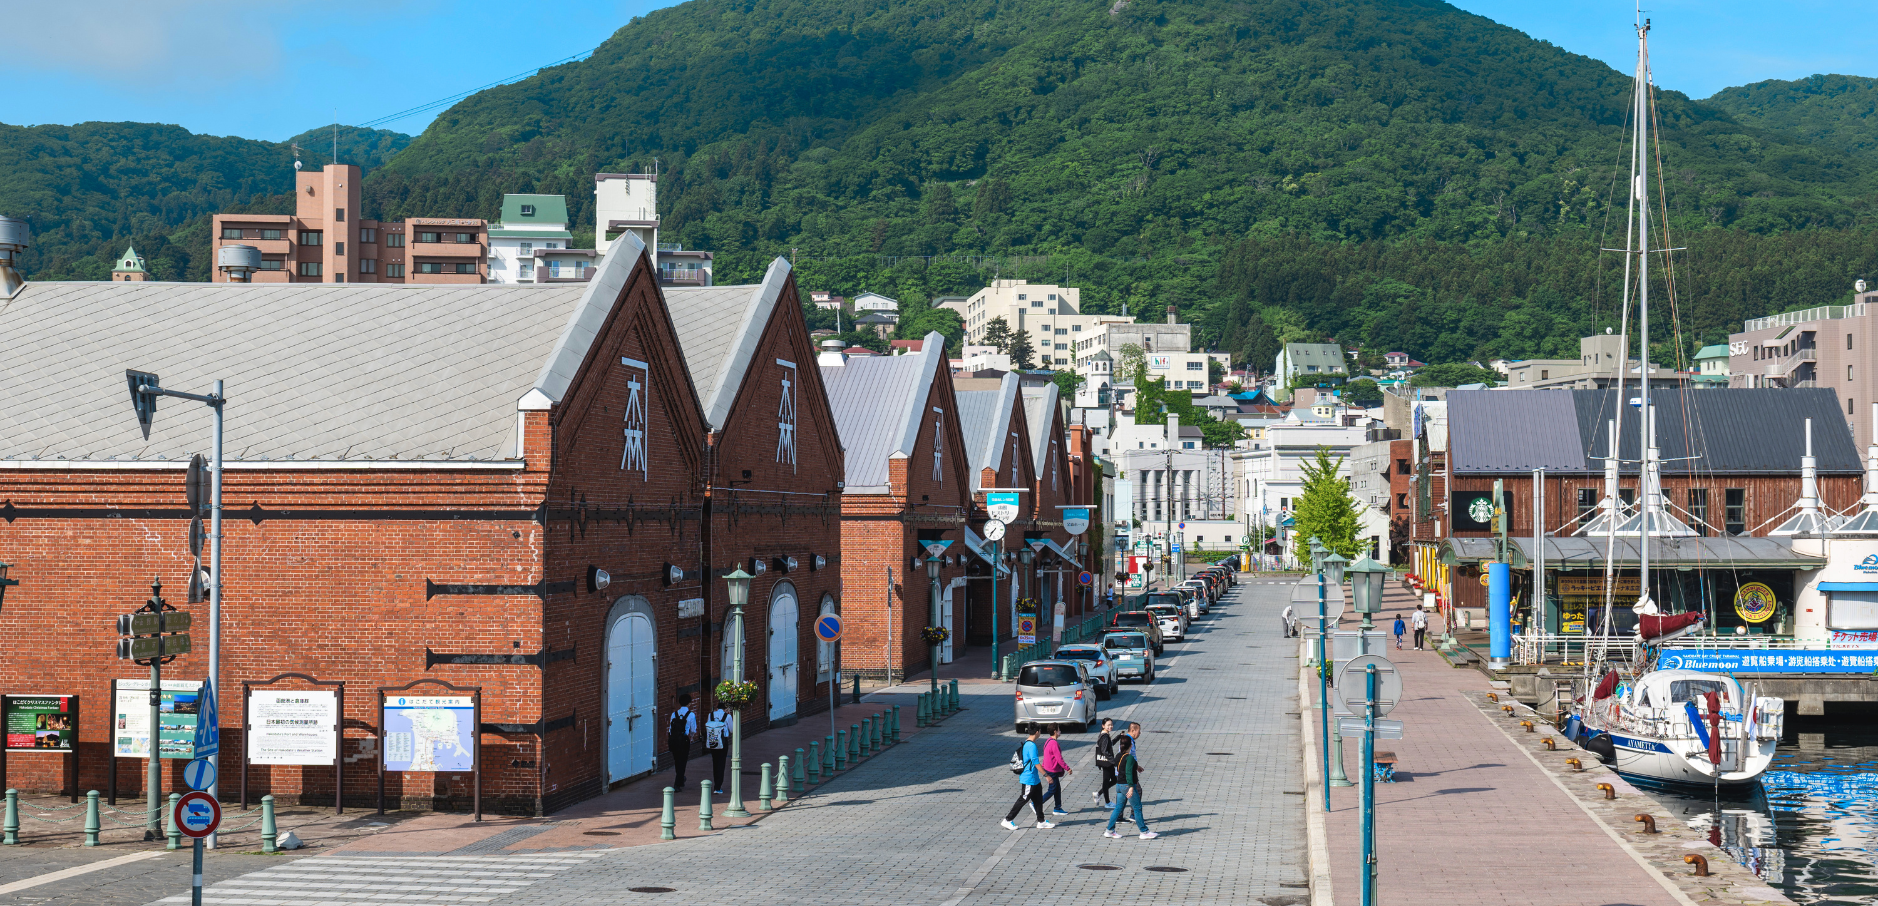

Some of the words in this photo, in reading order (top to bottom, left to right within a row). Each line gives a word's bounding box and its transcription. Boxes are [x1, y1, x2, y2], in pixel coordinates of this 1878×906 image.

[1729, 340, 1749, 357] SEC
[1832, 631, 1878, 642] チケット売場
[1684, 660, 1738, 668] Bluemoon
